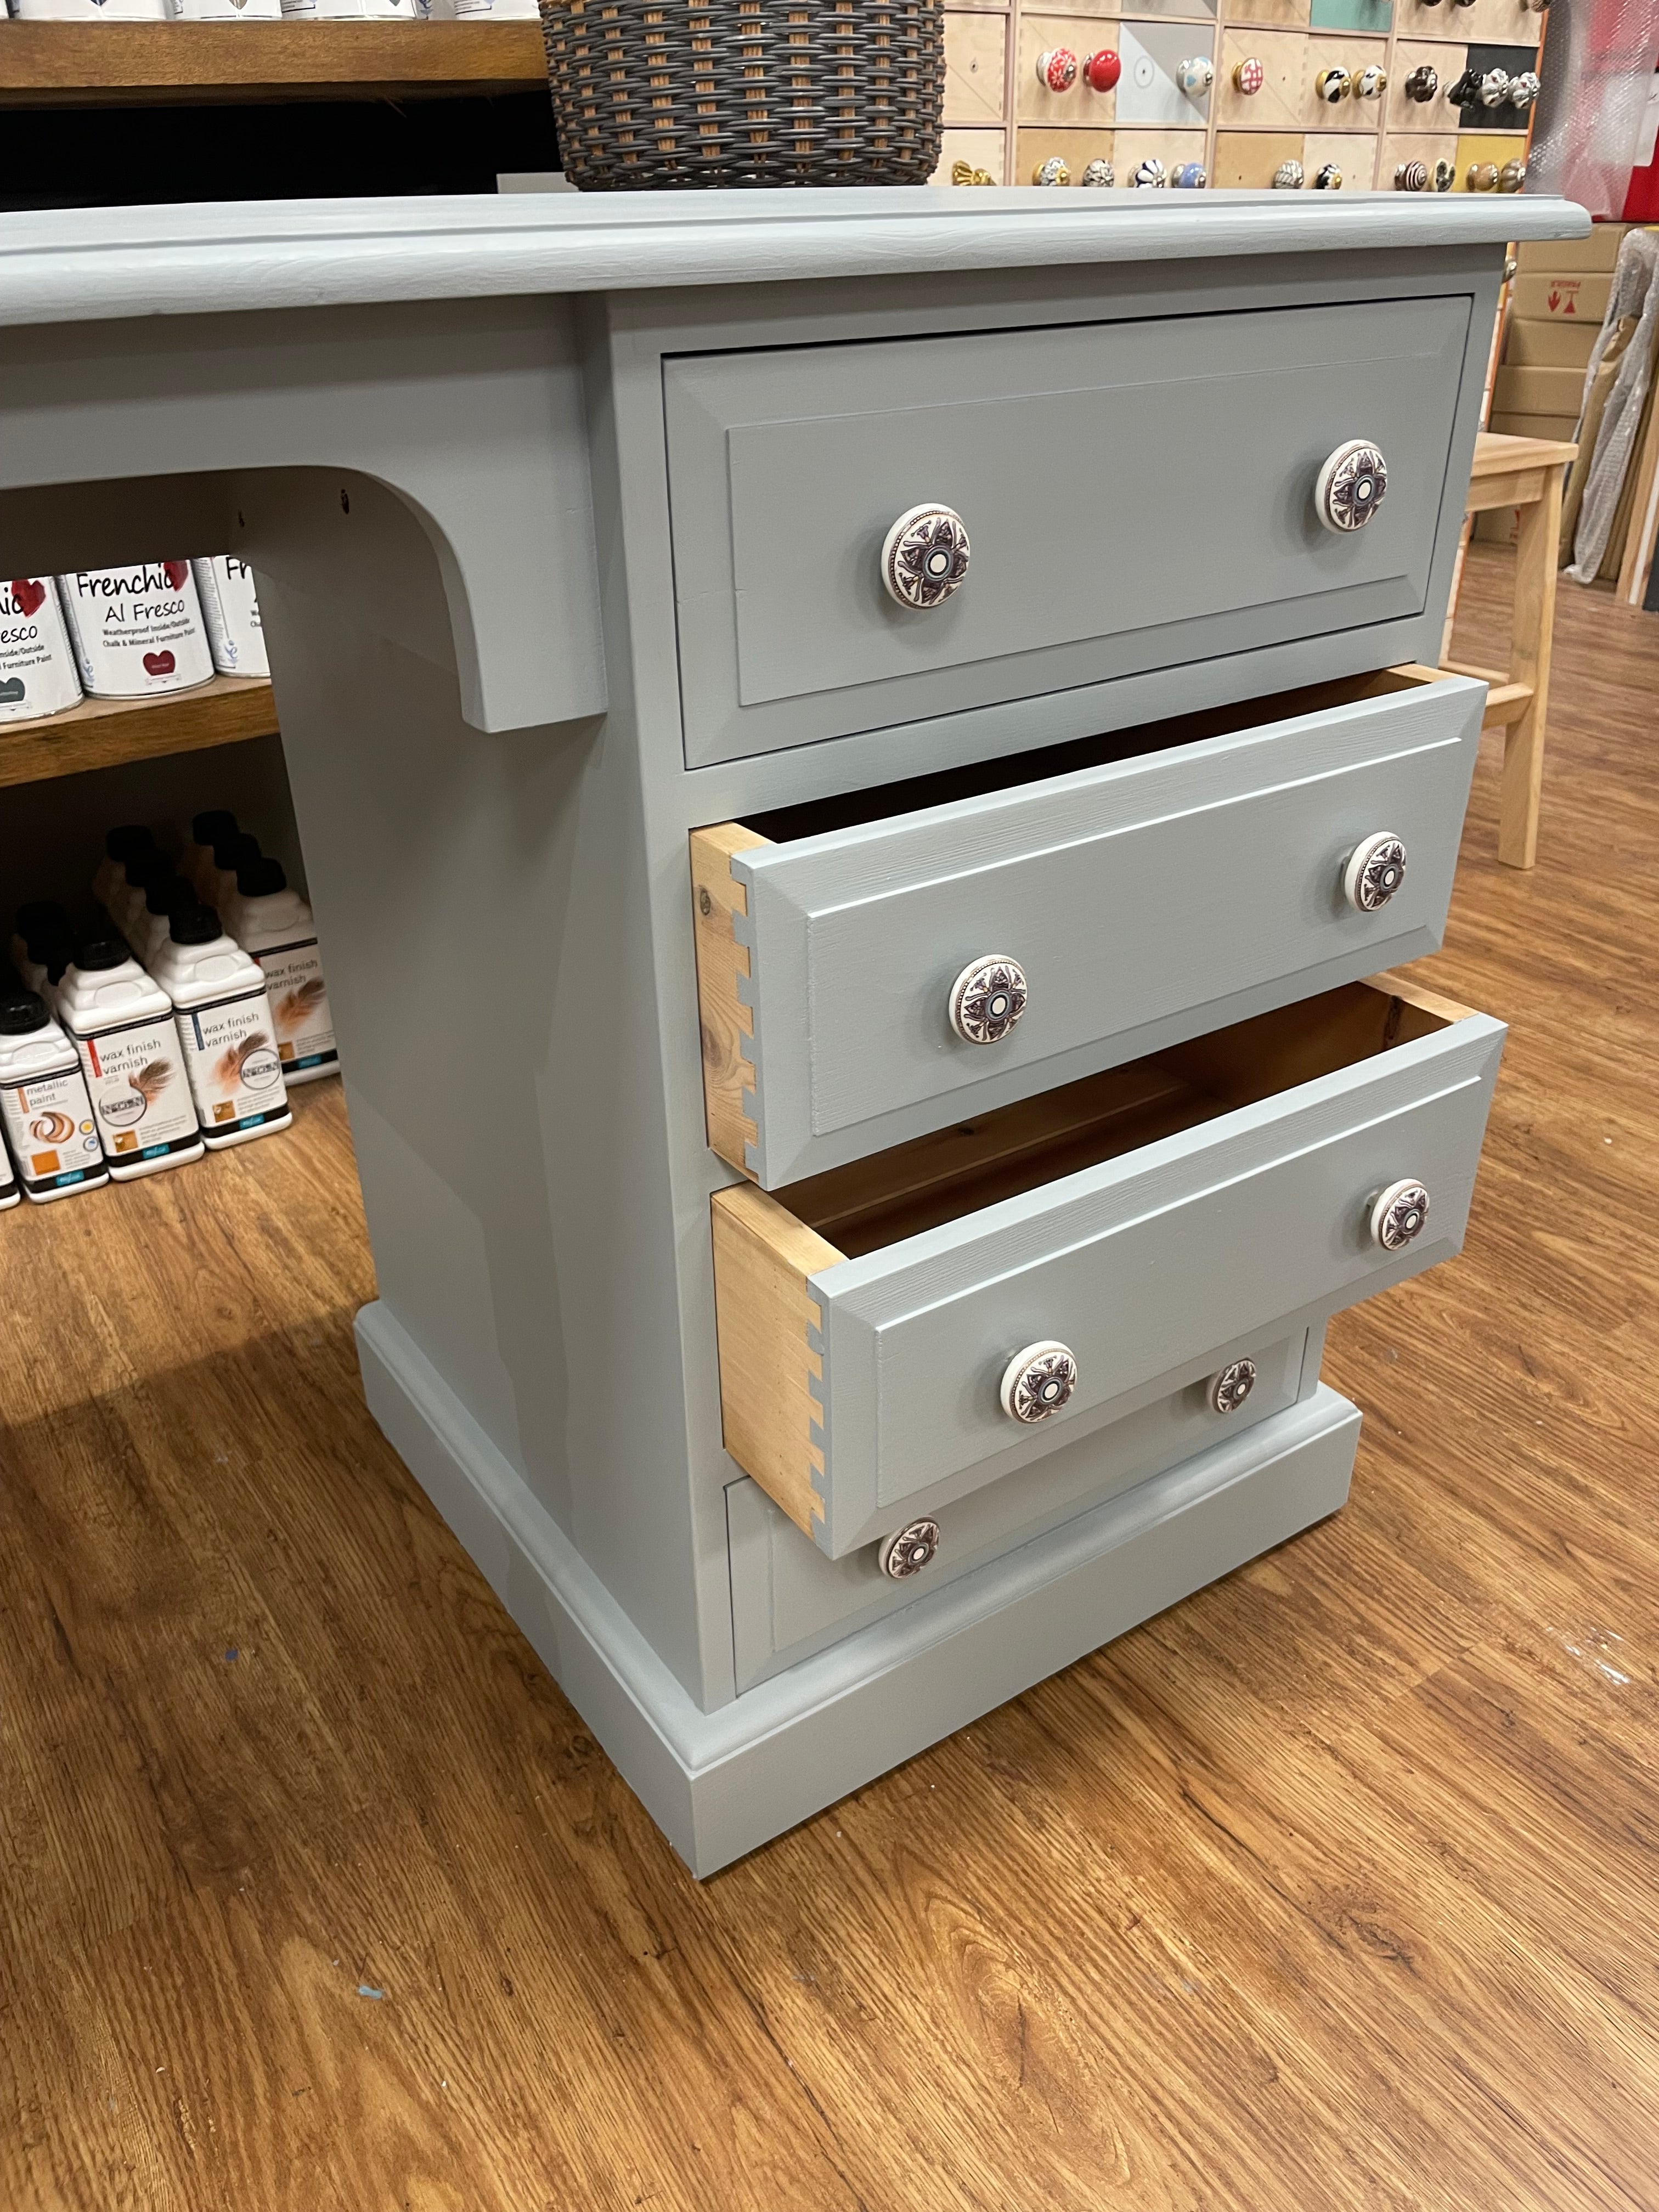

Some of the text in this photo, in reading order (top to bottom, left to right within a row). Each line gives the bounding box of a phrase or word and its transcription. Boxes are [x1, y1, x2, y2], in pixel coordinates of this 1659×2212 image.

[105, 600, 184, 622] Al Fresco
[0, 625, 38, 644] esco
[3, 653, 52, 670] Furniture Paint
[266, 959, 318, 979] wax finish
[266, 975, 306, 990] varnish
[203, 1012, 259, 1035] wax finish
[205, 1029, 247, 1047] varnish
[99, 1039, 161, 1063] wax finish
[103, 1056, 148, 1075] varnish
[27, 1079, 69, 1096] metallic
[30, 1093, 56, 1107] paint
